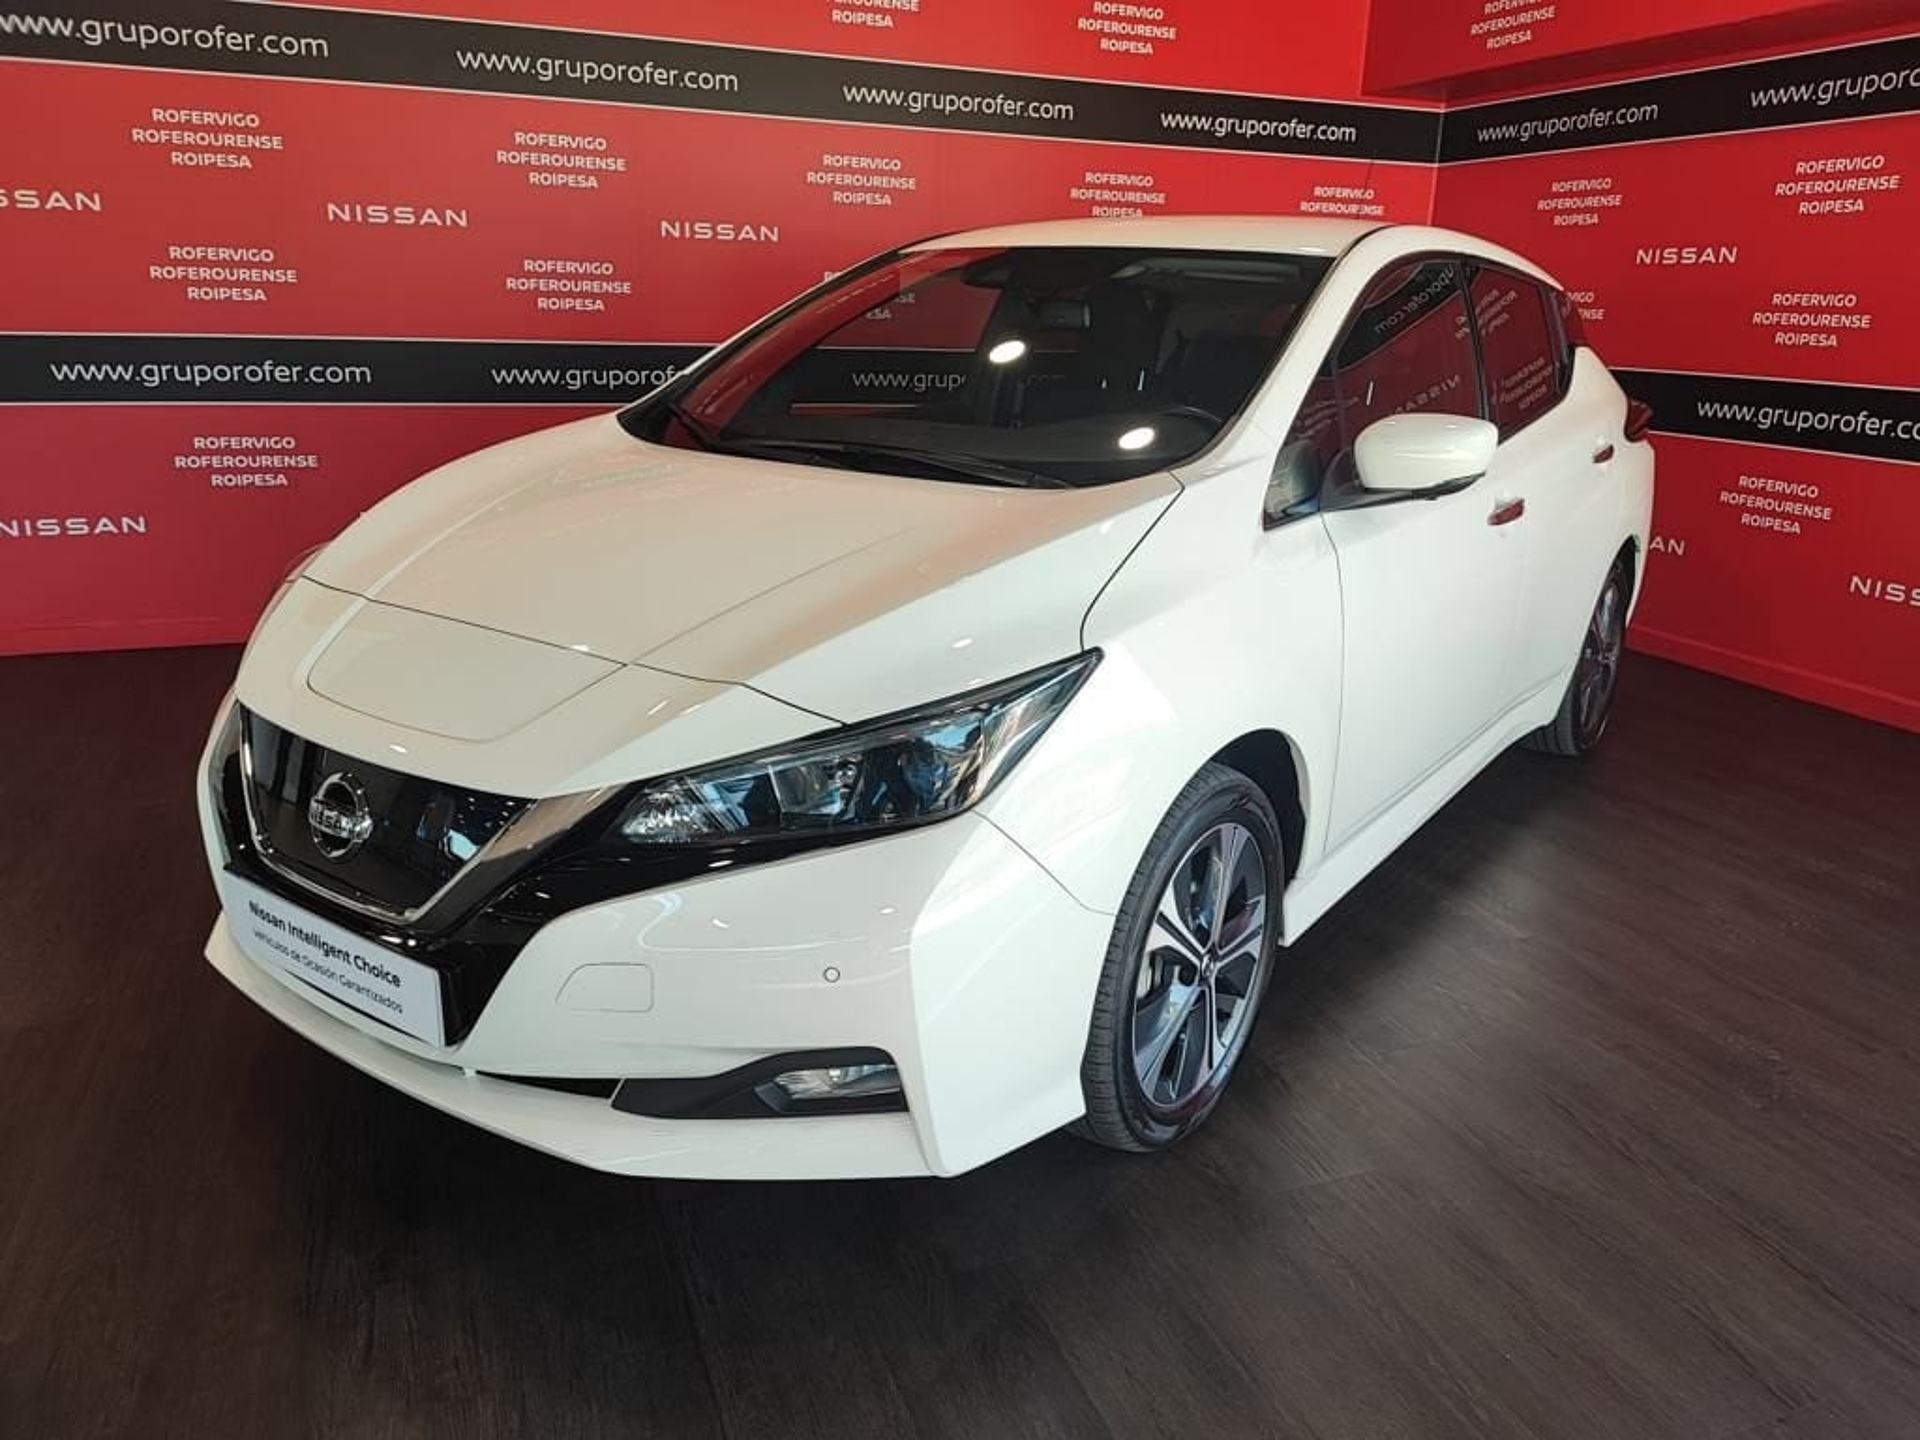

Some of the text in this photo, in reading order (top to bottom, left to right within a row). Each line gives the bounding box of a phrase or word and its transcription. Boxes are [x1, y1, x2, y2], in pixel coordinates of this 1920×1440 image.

[832, 9, 894, 28] ROIPESA
[1093, 1, 1164, 20] ROFERVIGO
[1077, 18, 1177, 40] ROFEROURENSE
[1470, 5, 1556, 35] ROFEROURENSE
[1100, 38, 1154, 54] ROIPESA
[1486, 29, 1532, 50] ROIPESA
[456, 50, 738, 92] www.gruporofer.com
[842, 85, 1074, 121] www.gruporofer.com
[151, 108, 260, 127] ROFERVIGO
[1477, 103, 1659, 142] www.gruporofer.com
[1160, 112, 1357, 142] www.gruporofer.com
[131, 128, 283, 150] ROFEROURENSE
[514, 132, 607, 150] ROFERVIGO
[171, 151, 252, 168] ROIPESA
[496, 150, 626, 171] ROFEROURENSE
[822, 155, 901, 171] ROFERVIGO
[1796, 155, 1884, 174] ROFERVIGO
[529, 172, 598, 189] ROIPESA
[807, 172, 916, 190] ROFEROURENSE
[1085, 172, 1154, 187] ROFERVIGO
[1551, 178, 1612, 193] ROFERVIGO
[1775, 175, 1900, 196] ROFEROURENSE
[833, 190, 892, 206] ROIPESA
[1537, 194, 1622, 211] ROFEROURENSE
[1799, 199, 1864, 215] ROIPESA
[327, 204, 467, 227] NISSAN
[1553, 213, 1599, 226] ROIPESA
[661, 220, 779, 242] NISSAN
[169, 247, 274, 262] ROFERVIGO
[1636, 246, 1738, 265] NISSAN
[150, 266, 297, 283] ROFEROURENSE
[524, 259, 614, 275] ROFERVIGO
[187, 287, 266, 301] ROIPESA
[506, 278, 631, 294] ROFEROURENSE
[538, 298, 605, 310] ROIPESA
[1772, 293, 1857, 307] ROFERVIGO
[1752, 312, 1871, 329] ROFEROURENSE
[1775, 331, 1837, 347] ROIPESA
[51, 360, 372, 387] www.gruporofer.com
[193, 437, 295, 449] ROFERVIGO
[175, 456, 318, 468] ROFEROURENSE
[211, 474, 288, 487] ROIPESA
[1738, 475, 1819, 498] ROFERVIGO
[1720, 491, 1832, 521] ROFEROURENSE
[1741, 513, 1801, 535] ROIPESA
[249, 900, 401, 988] Nissan Intelligent Choice
